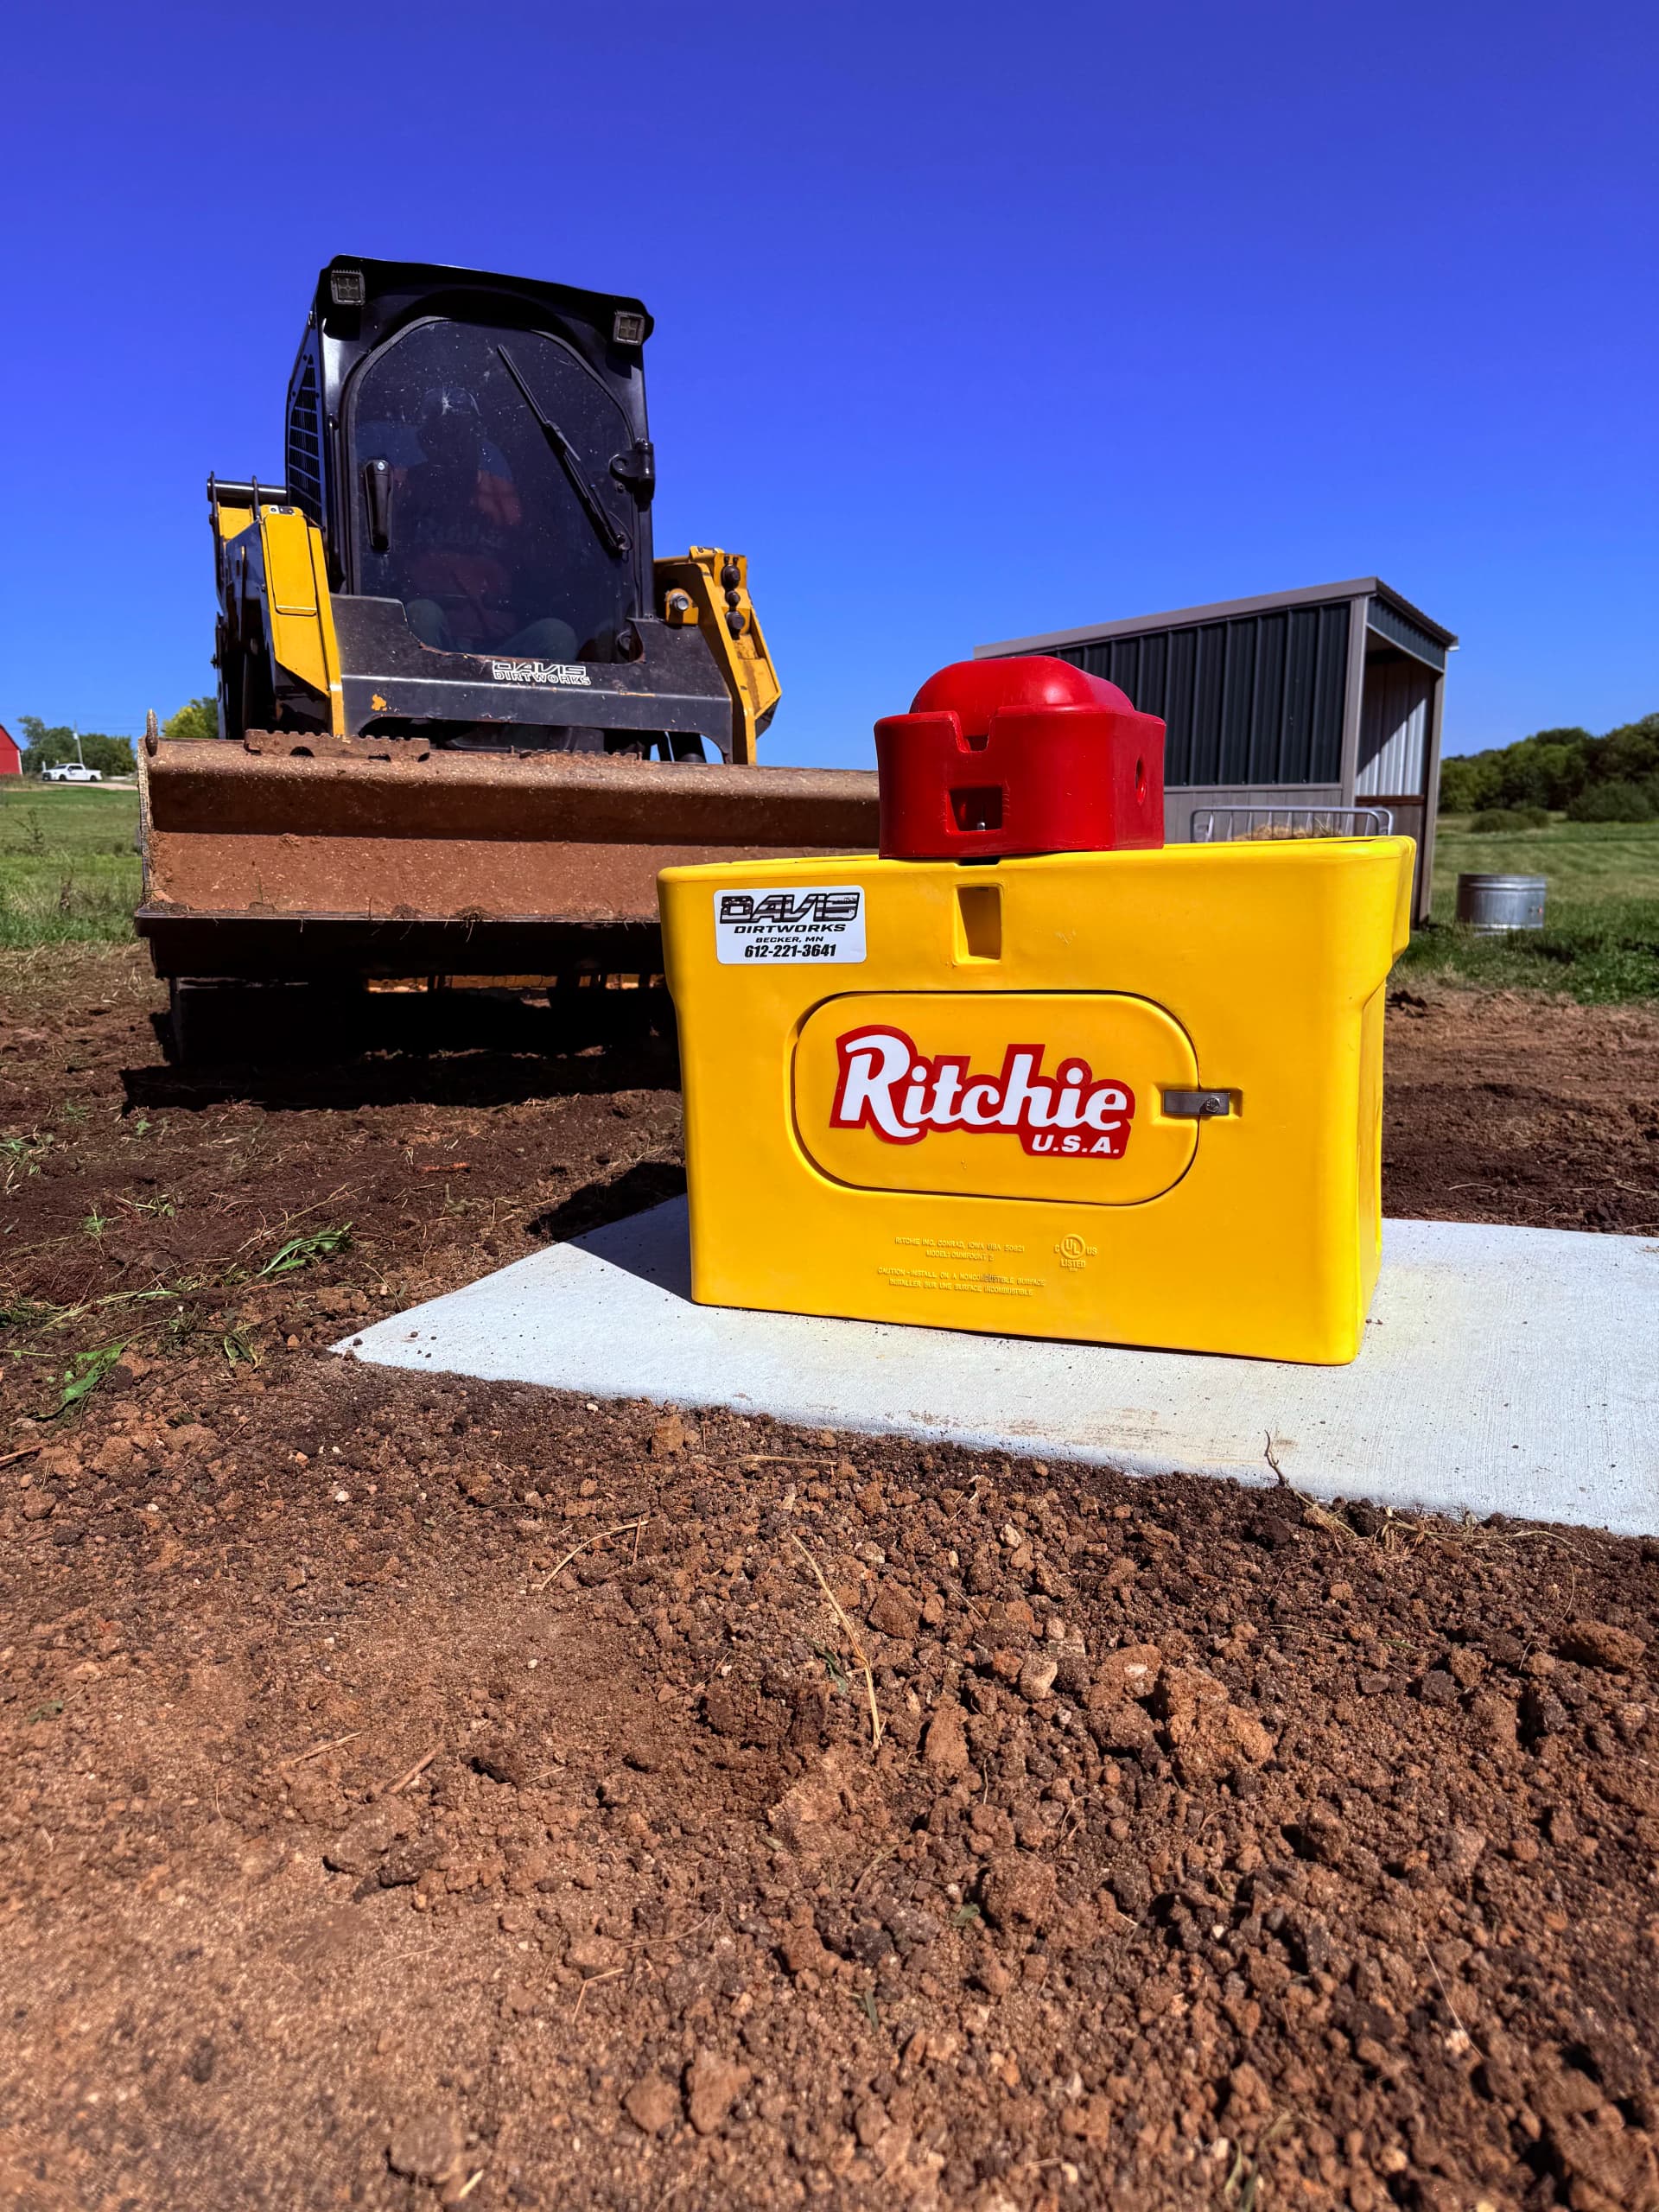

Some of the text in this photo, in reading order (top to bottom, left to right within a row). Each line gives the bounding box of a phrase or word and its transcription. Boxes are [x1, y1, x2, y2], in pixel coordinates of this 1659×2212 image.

[493, 660, 586, 676] DAVIS
[493, 671, 591, 685] DIRTWORKS
[720, 893, 860, 924] DAVIS
[734, 924, 846, 934] DIRTWORKS
[745, 944, 836, 957] 612-221-3641
[839, 1033, 1128, 1138] Ritchie
[1031, 1134, 1121, 1154] U.S.A.
[895, 1236, 920, 1246] RITCHIE
[1086, 1246, 1097, 1256] US
[1060, 1258, 1086, 1268] LISTED
